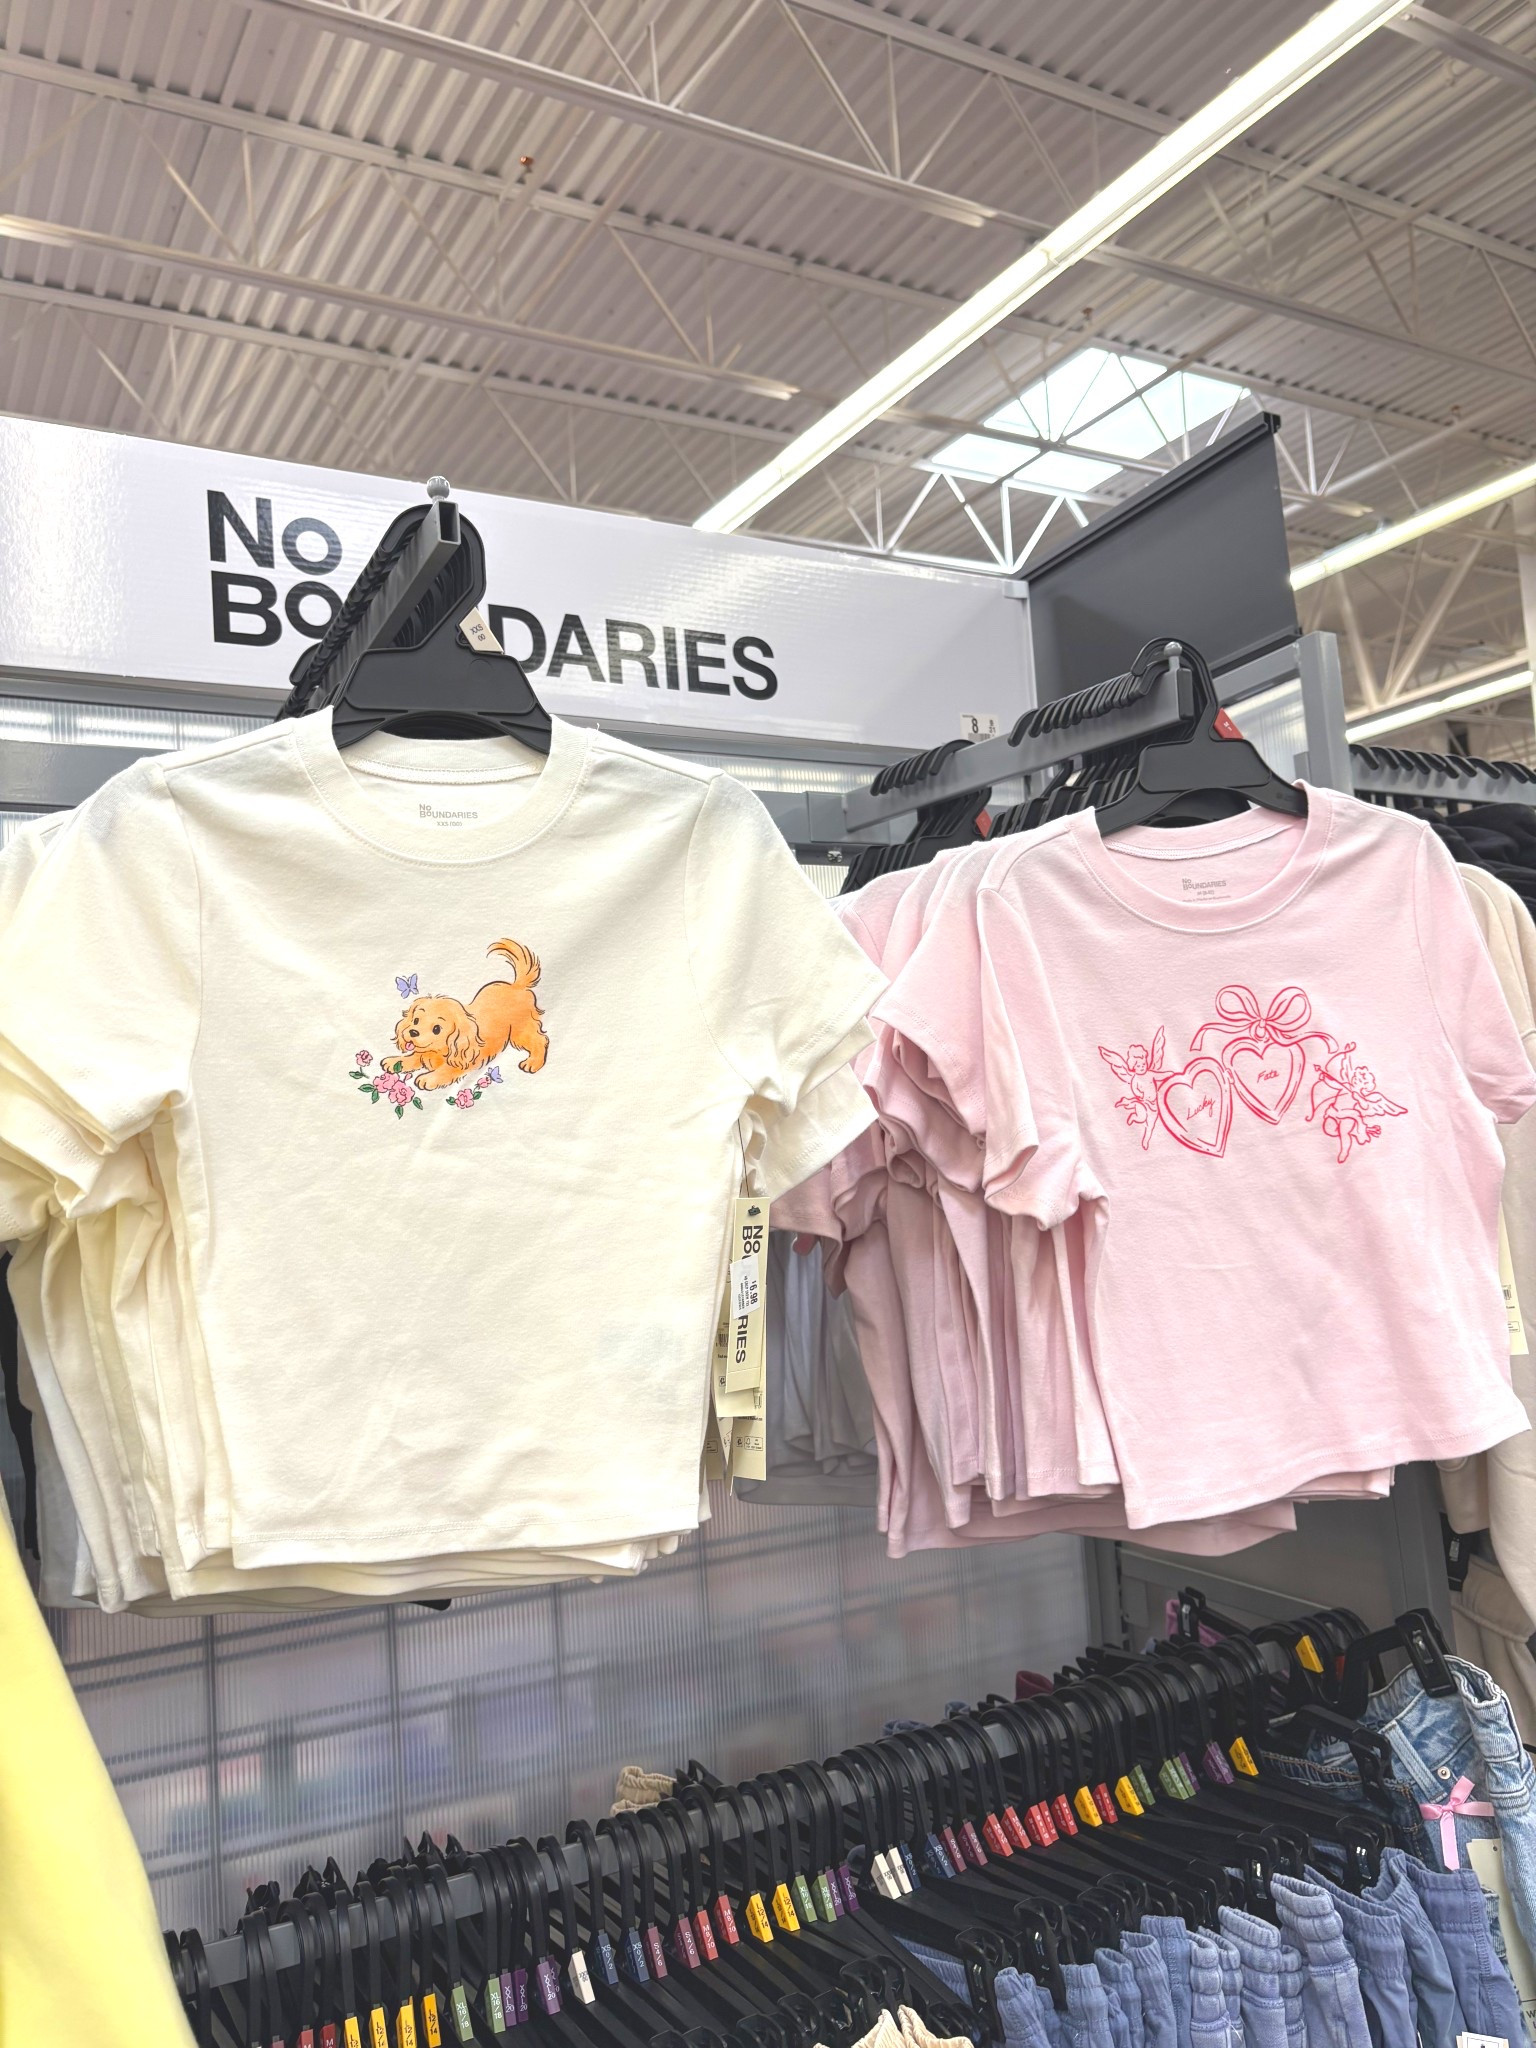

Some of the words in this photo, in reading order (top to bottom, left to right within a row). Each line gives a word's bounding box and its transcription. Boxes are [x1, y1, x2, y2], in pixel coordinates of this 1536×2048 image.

[470, 624, 484, 635] XXS
[971, 718, 979, 734] 8
[1186, 1095, 1216, 1120] Lucky
